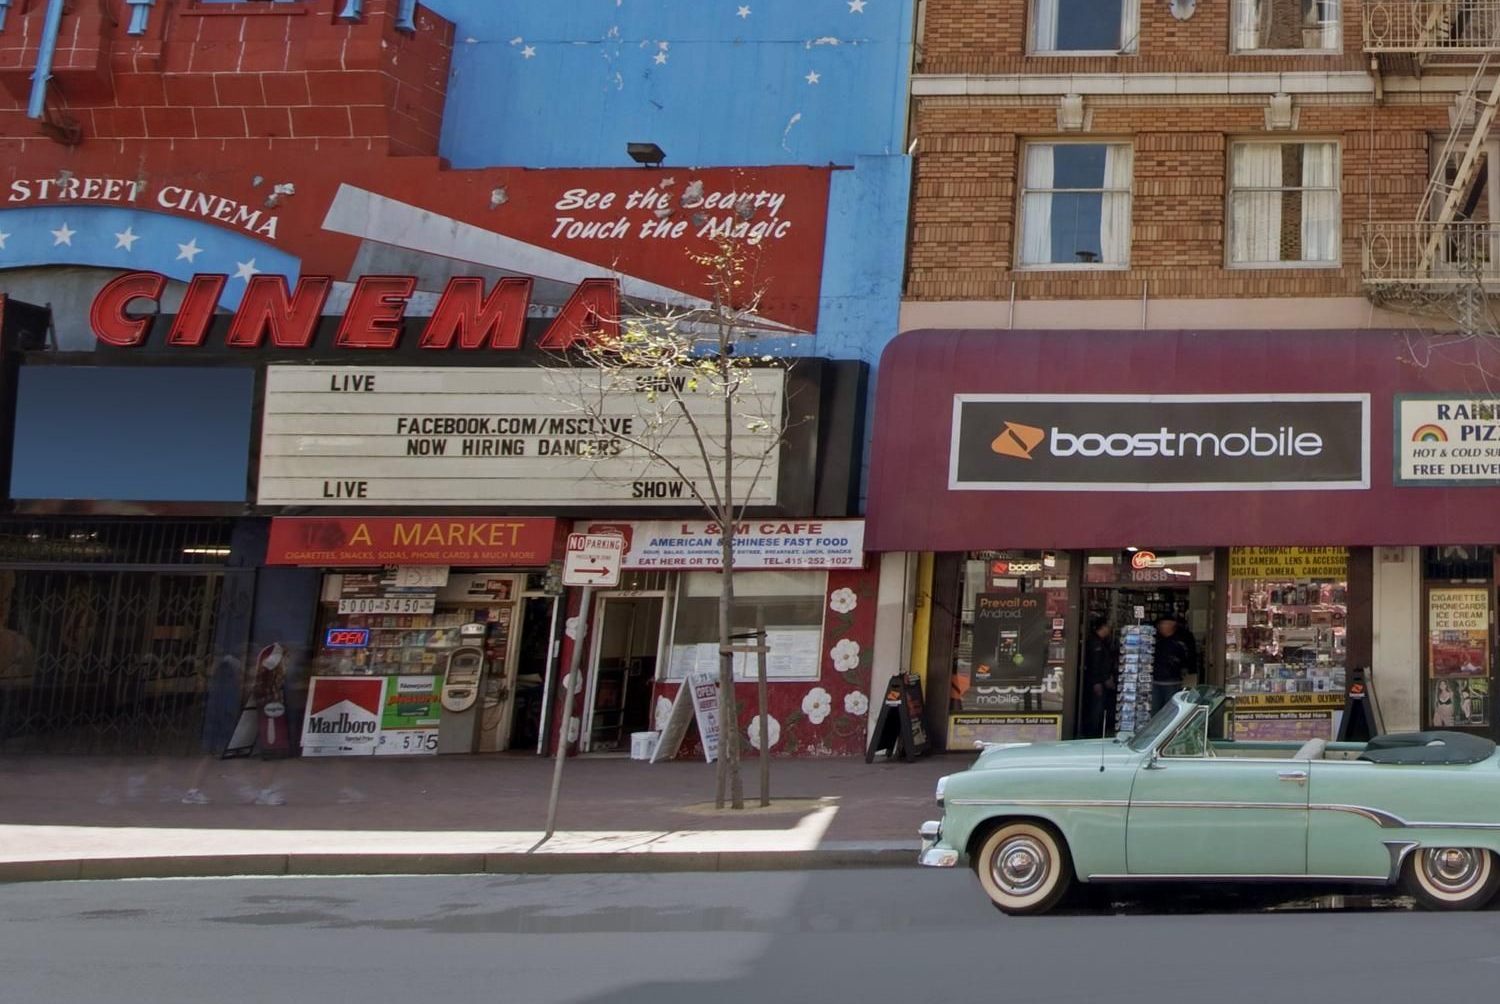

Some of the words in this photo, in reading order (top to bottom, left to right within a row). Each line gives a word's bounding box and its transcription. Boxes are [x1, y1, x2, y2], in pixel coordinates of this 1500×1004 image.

[555, 188, 617, 211] See
[625, 188, 671, 210] the
[9, 178, 140, 203] STREET
[157, 186, 278, 239] CINEMA
[551, 217, 631, 239] Touch
[639, 218, 688, 239] the
[696, 217, 791, 245] Magic
[89, 270, 620, 351] CINEMA
[331, 374, 376, 392] LIVE
[406, 438, 447, 456] NOW
[461, 438, 525, 456] HIRING
[537, 438, 622, 456] DANCERS
[1412, 448, 1437, 457] HOT
[1440, 448, 1447, 457] &
[1451, 447, 1482, 457] COLD
[1412, 464, 1445, 475] FREE
[323, 481, 368, 498] LIVE
[348, 523, 372, 546] A
[392, 523, 525, 546] MARKET
[681, 524, 695, 535] L
[704, 524, 721, 535] &
[759, 524, 823, 535] CAFE
[569, 536, 585, 550] NO
[586, 539, 621, 550] PARKING
[649, 538, 712, 547] AMERICAN
[784, 538, 813, 546] FAST
[816, 538, 848, 546] FOOD
[689, 557, 705, 565] OR
[707, 557, 720, 565] TO
[1231, 556, 1246, 565] SLR
[1008, 562, 1042, 572] boost
[1231, 567, 1260, 576] DIGITAL
[980, 598, 1020, 608] Prevail
[1022, 600, 1037, 608] on
[1431, 594, 1486, 602] CIGARETTES
[980, 608, 1021, 618] Android
[1453, 611, 1483, 619] CREAM
[1453, 620, 1477, 628] BAGS
[329, 632, 365, 645] OPEN
[976, 694, 1020, 704] mobile
[307, 713, 377, 734] Marlboro
